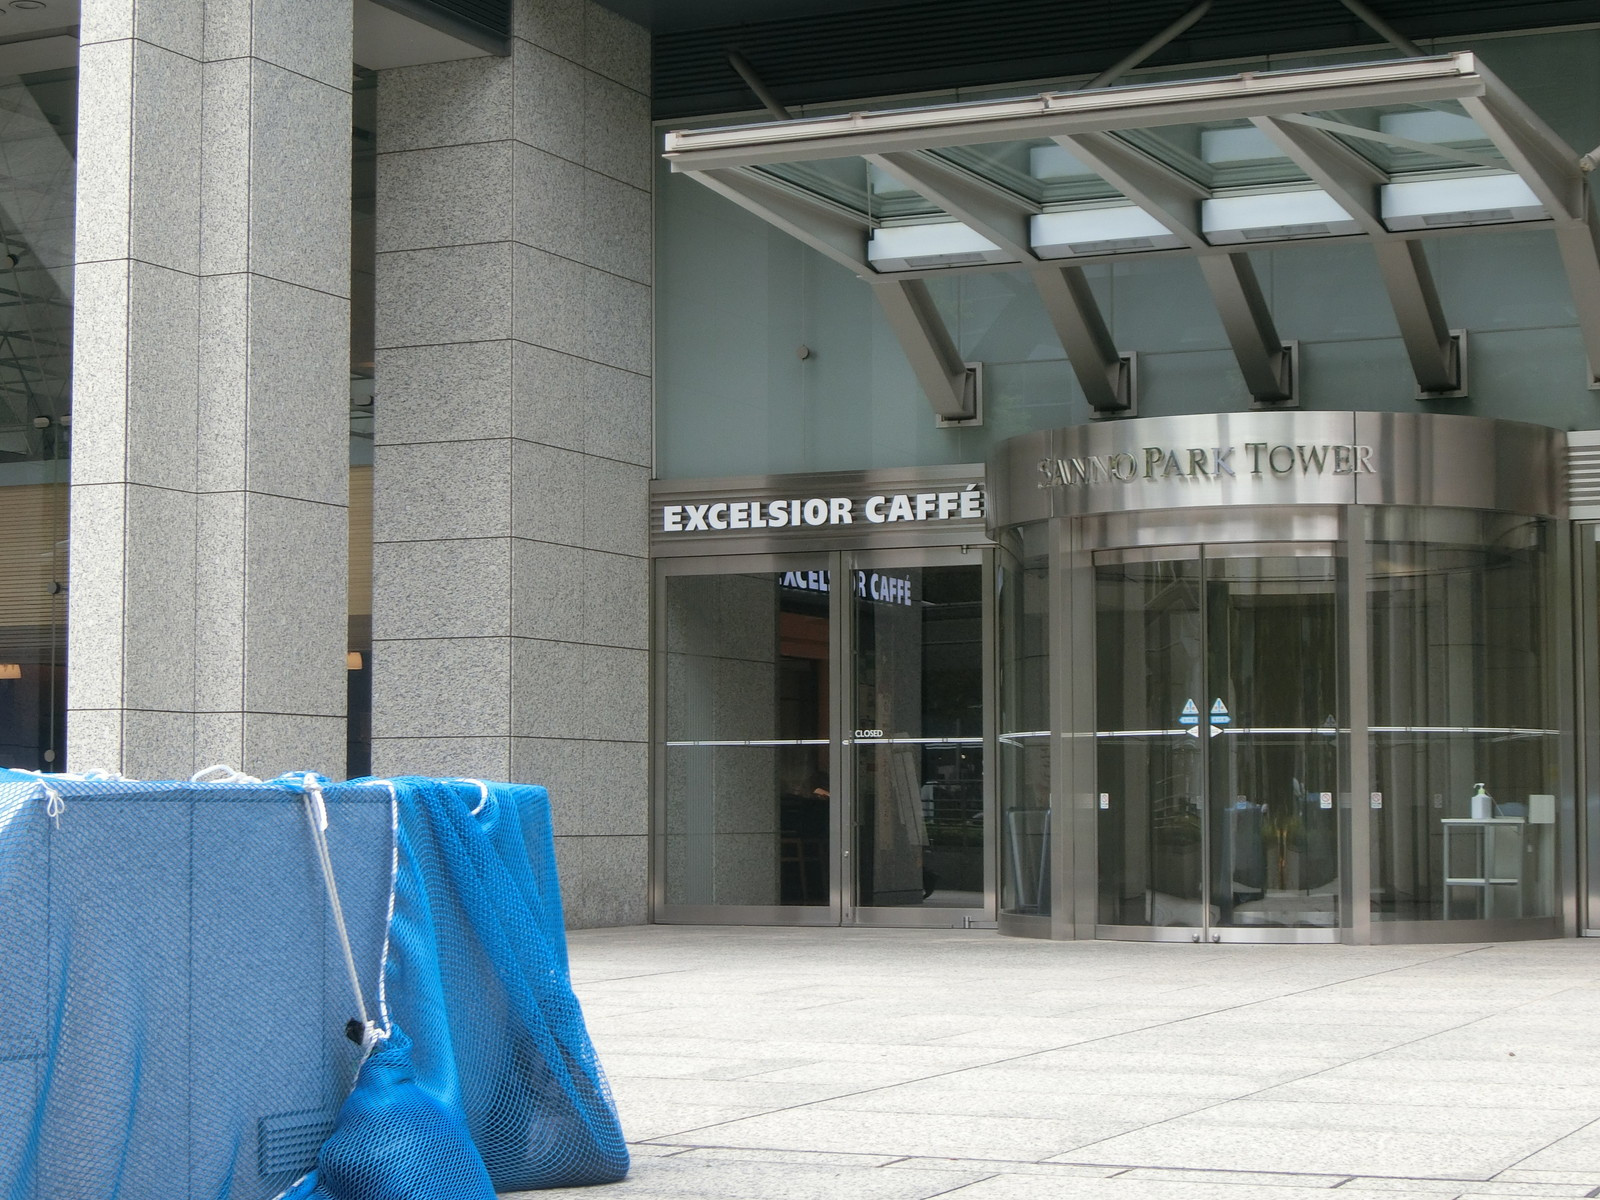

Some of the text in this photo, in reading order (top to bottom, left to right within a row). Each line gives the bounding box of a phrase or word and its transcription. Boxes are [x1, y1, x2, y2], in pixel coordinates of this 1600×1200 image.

[1037, 441, 1377, 488] SANNO PARK TOWER
[663, 483, 983, 532] EXCELSIOR CAFFÉ
[870, 573, 912, 606] CAFFÉ
[854, 729, 884, 738] CLOSED
